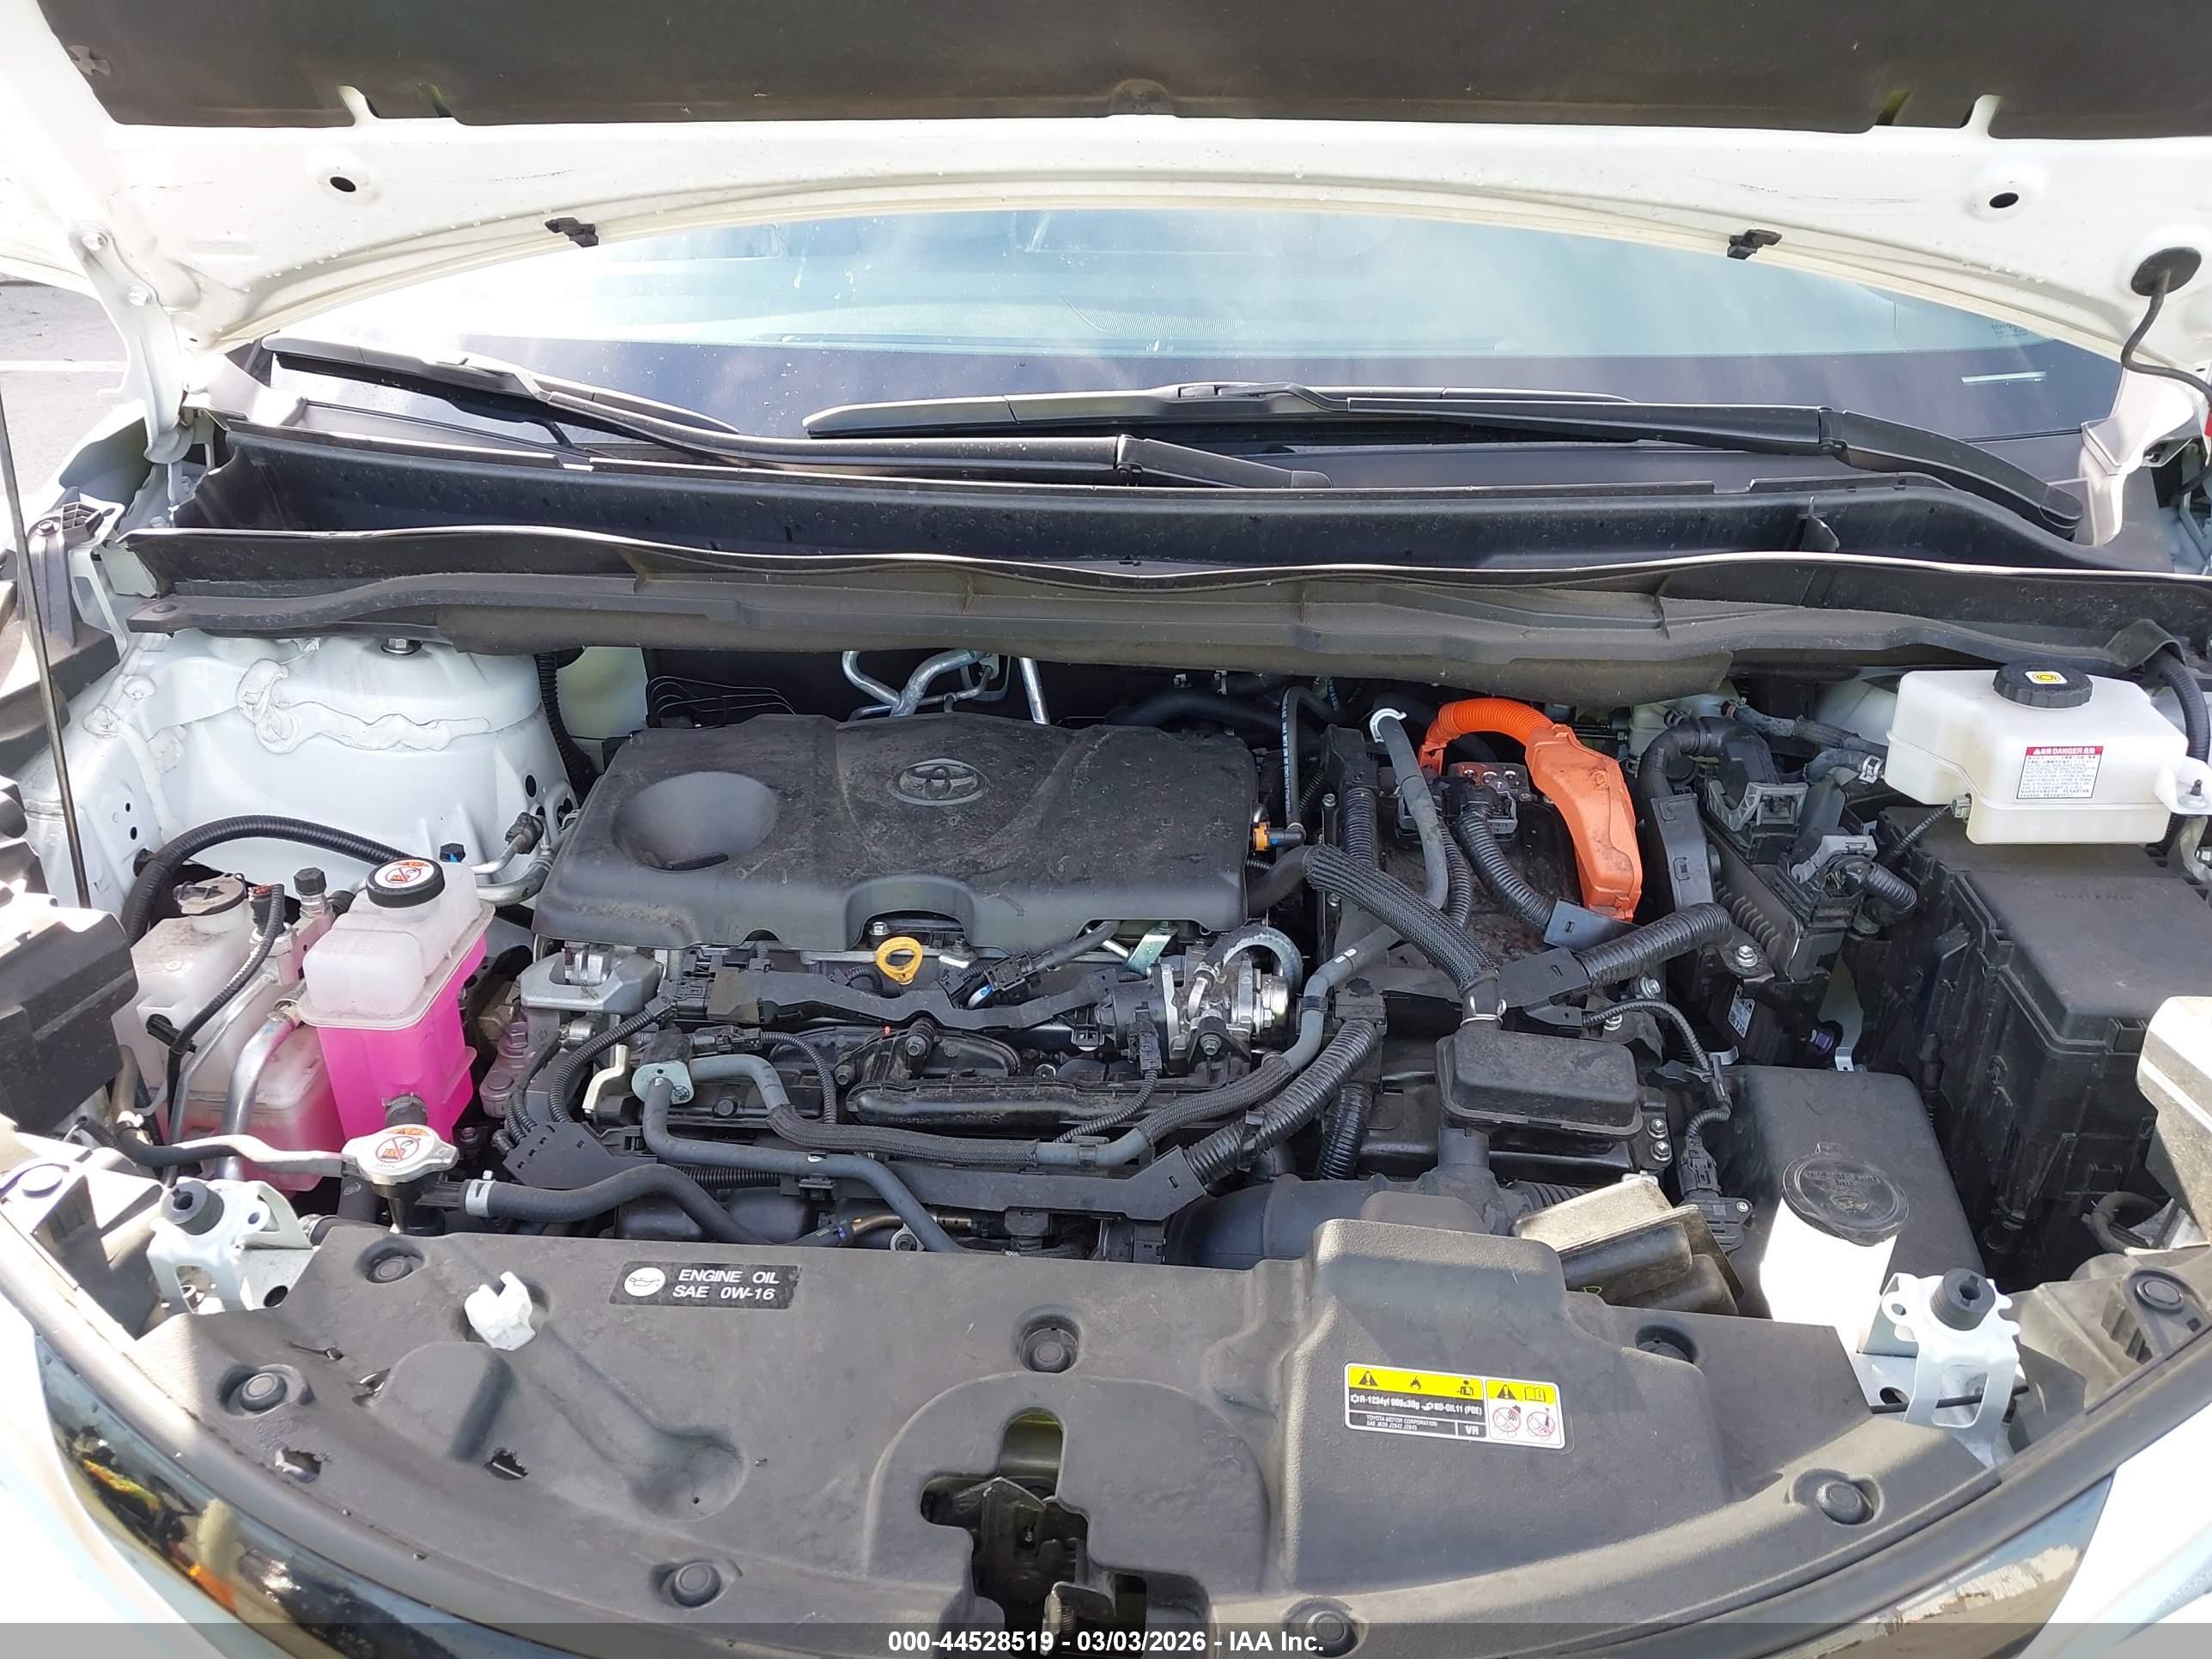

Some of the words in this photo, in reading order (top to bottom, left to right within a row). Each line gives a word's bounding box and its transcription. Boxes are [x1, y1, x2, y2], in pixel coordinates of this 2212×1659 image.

[678, 1268, 743, 1283] ENGINE
[752, 1271, 781, 1285] OIL
[672, 1285, 710, 1298] SAE
[720, 1286, 776, 1301] 0W-16
[1404, 1419, 1437, 1427] CORPORATION
[1465, 1425, 1480, 1436] VR
